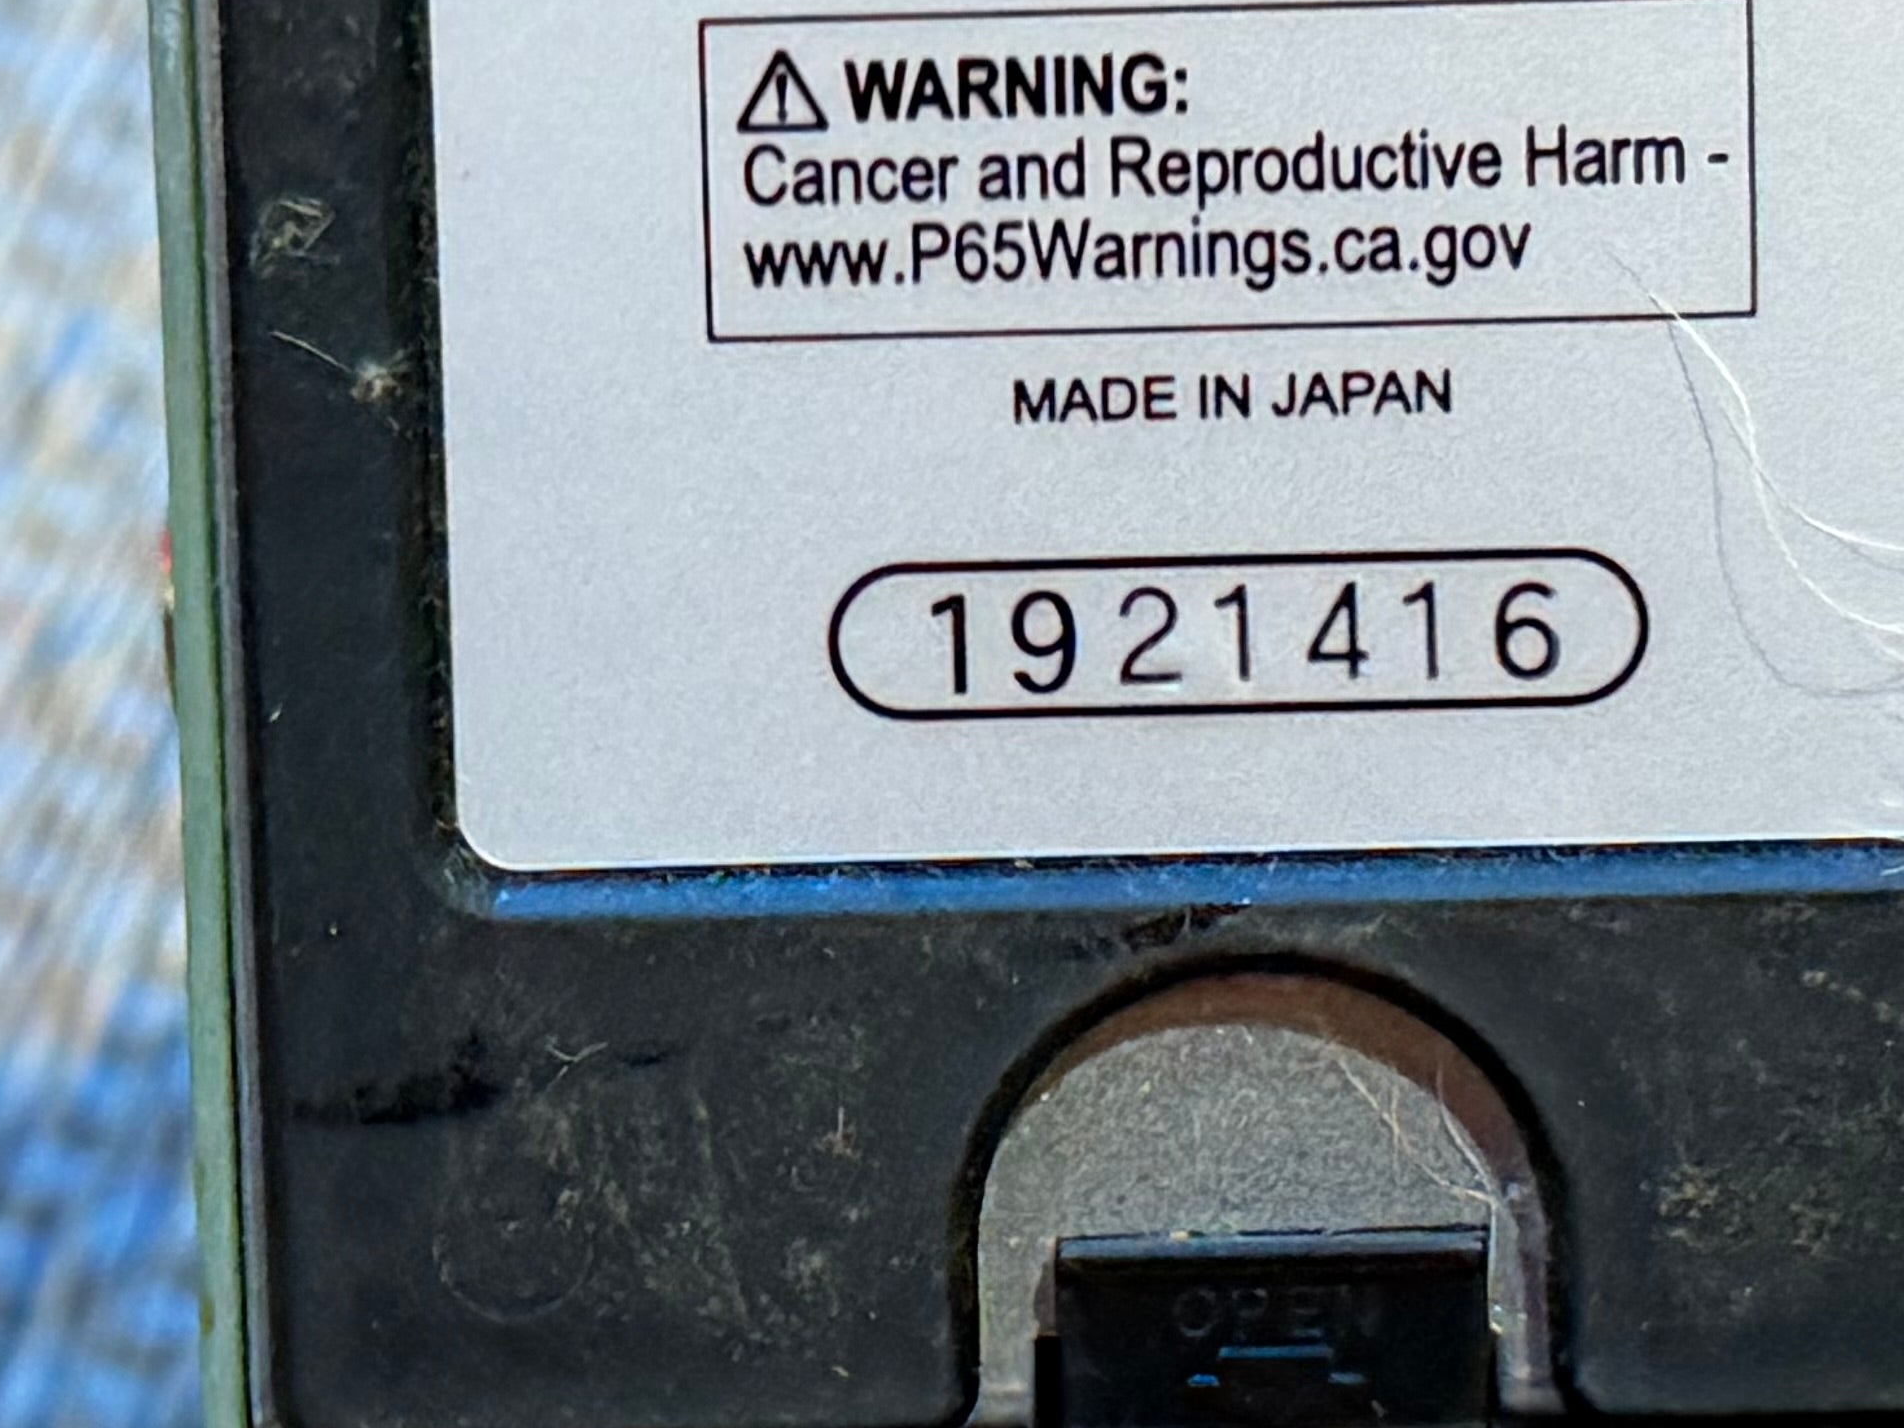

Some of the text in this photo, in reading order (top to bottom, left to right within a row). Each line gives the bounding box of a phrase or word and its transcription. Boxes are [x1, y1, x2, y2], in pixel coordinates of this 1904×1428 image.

[843, 52, 1189, 123] WARNING:
[742, 141, 960, 207] Cancer
[977, 136, 1087, 201] and
[1109, 128, 1504, 210] Reproductive
[1525, 123, 1687, 188] Harm
[744, 214, 1533, 292] www.P65Warnings.ca.gov
[1012, 367, 1453, 426] MADE IN JAPAN
[929, 581, 1559, 695] 1921416
